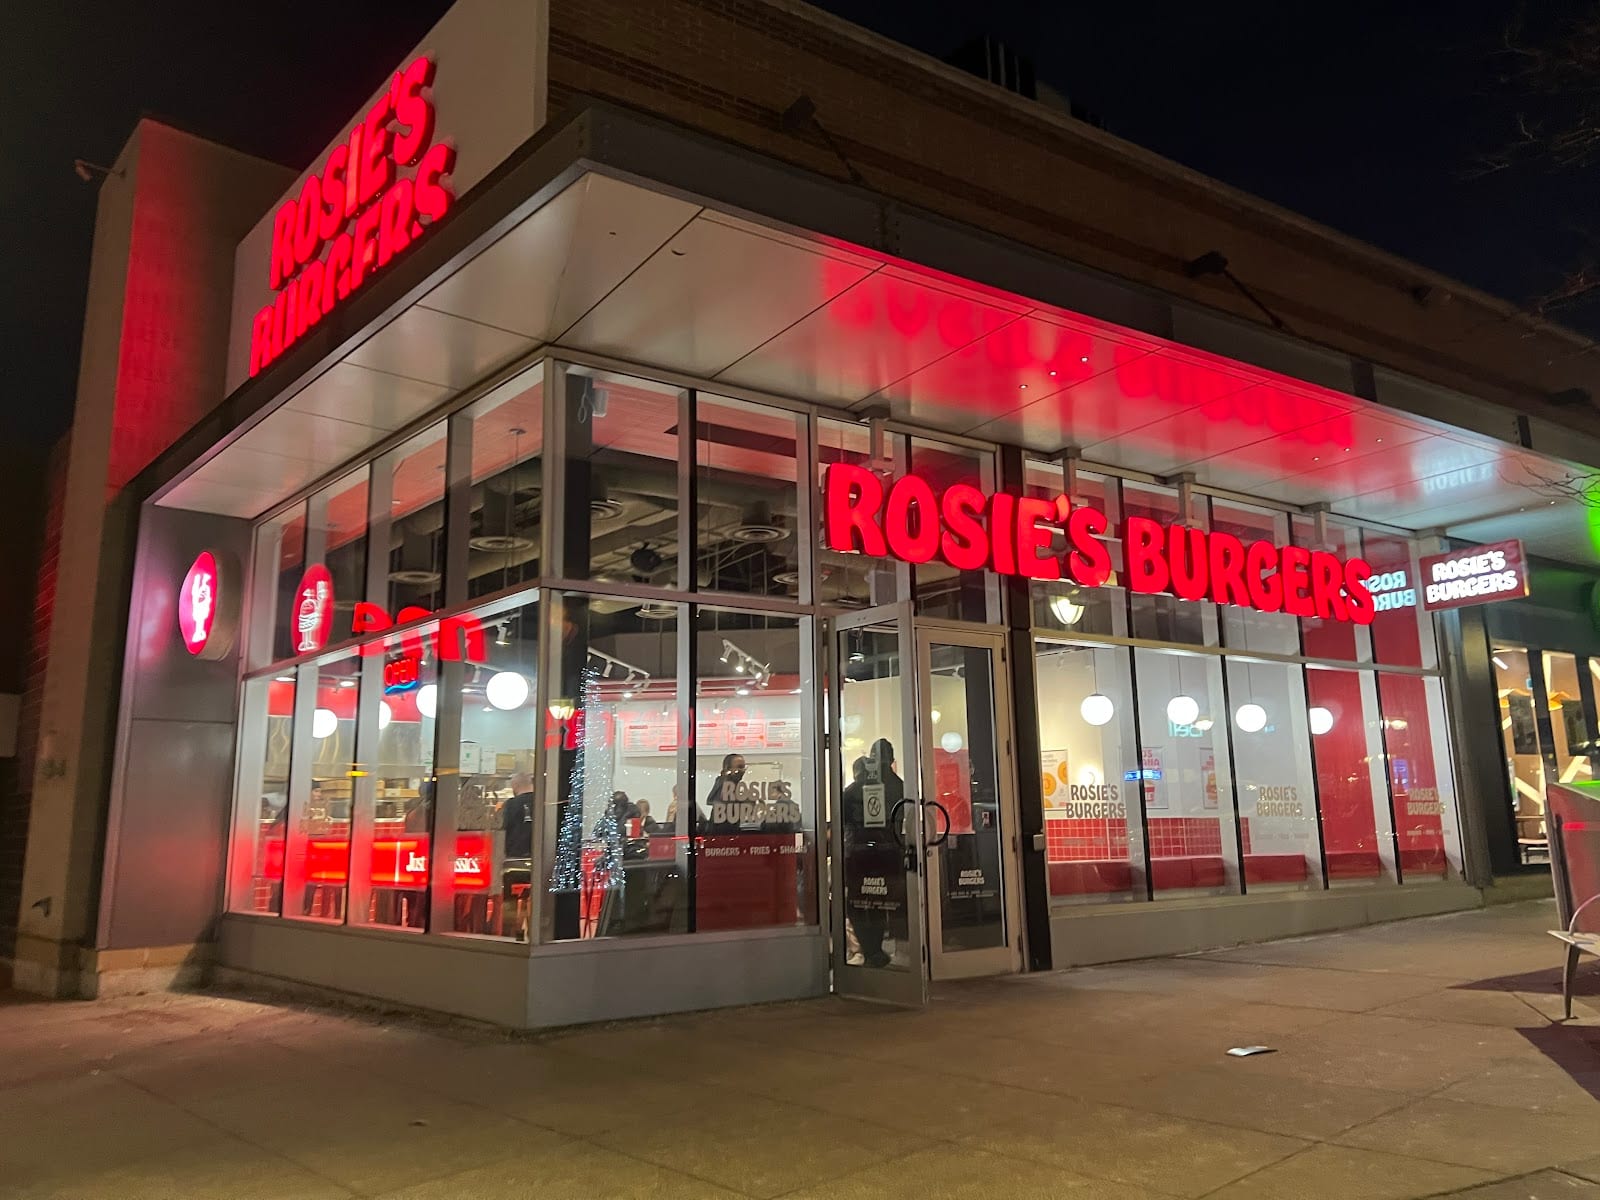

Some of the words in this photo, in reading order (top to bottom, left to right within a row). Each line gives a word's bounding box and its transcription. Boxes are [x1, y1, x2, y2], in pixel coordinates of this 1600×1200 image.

[270, 57, 434, 289] ROSIE'S
[826, 462, 1112, 588] ROSIE'S
[1126, 516, 1375, 625] BURGERS
[1432, 551, 1506, 582] ROSIE'S
[1426, 570, 1518, 603] BURGERS
[1071, 783, 1118, 801] ROSIE'S
[1259, 785, 1298, 801] ROSIE'S
[713, 801, 801, 824] BURGERS
[1066, 802, 1125, 819] BURGERS
[1256, 802, 1303, 817] BURGERS
[705, 847, 740, 858] BURGERS
[750, 846, 771, 855] FRIES
